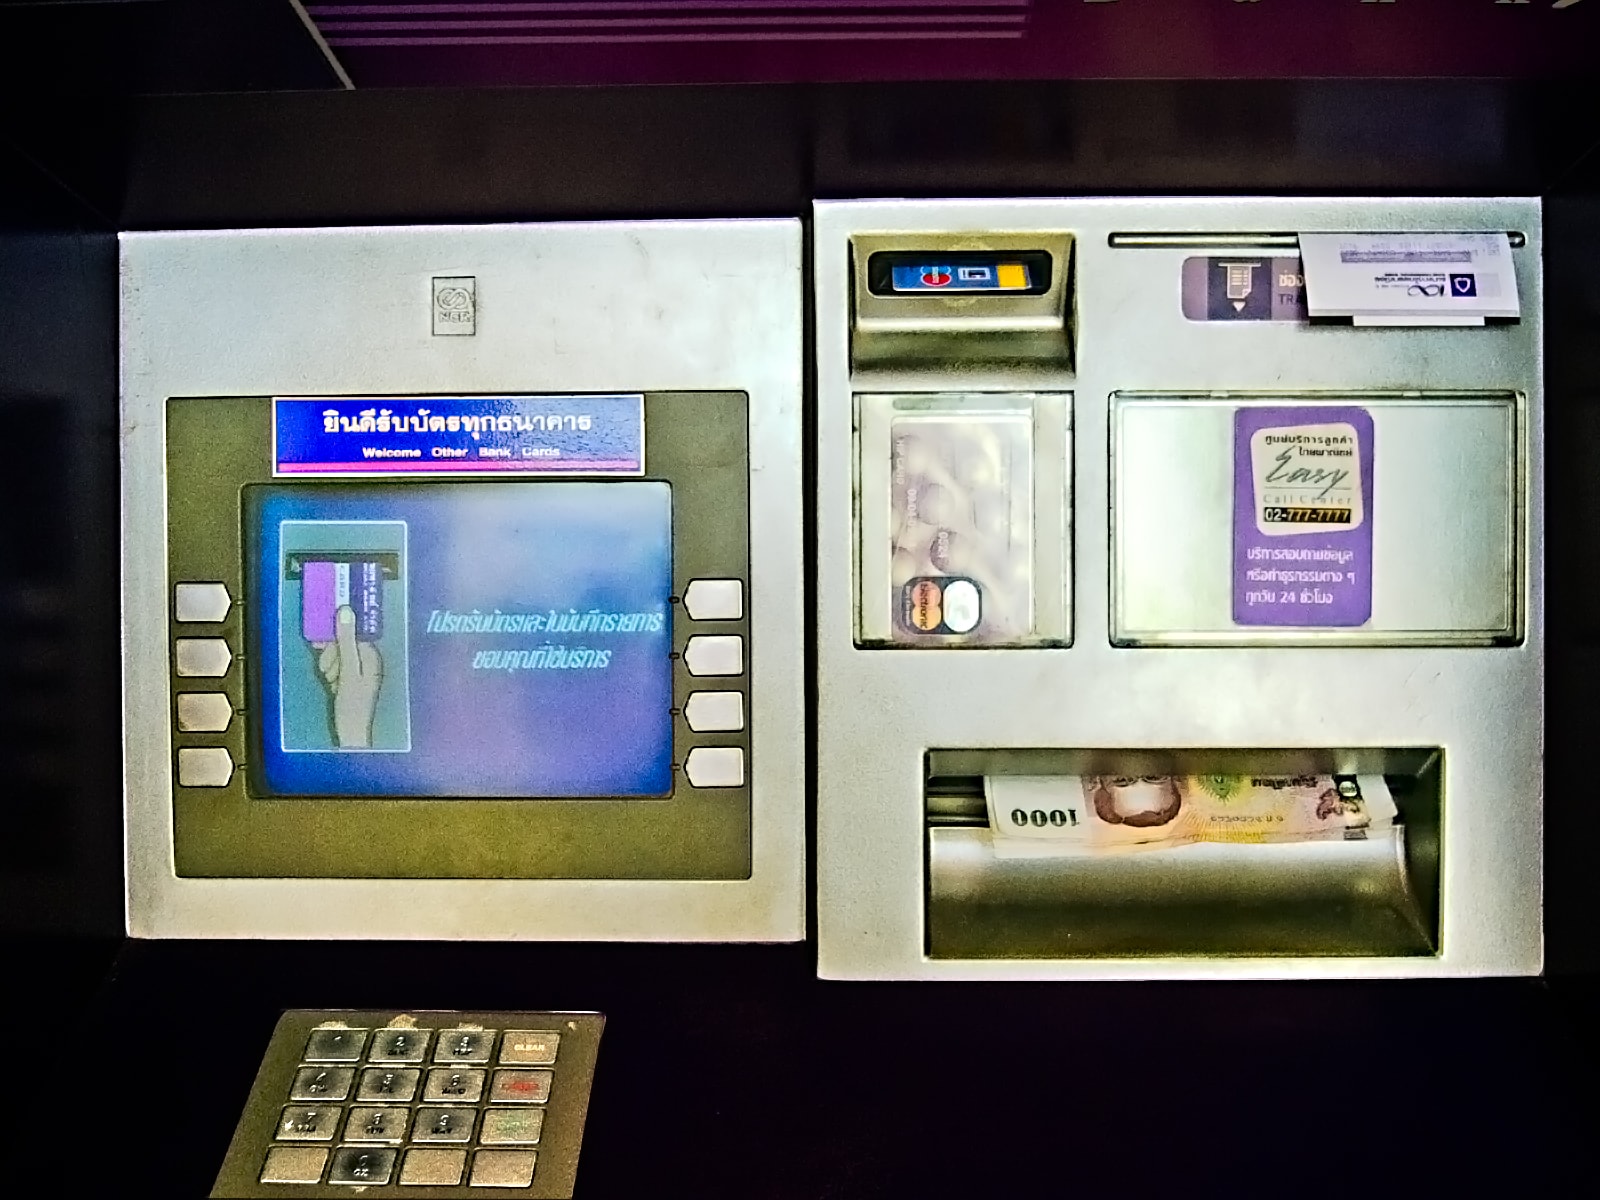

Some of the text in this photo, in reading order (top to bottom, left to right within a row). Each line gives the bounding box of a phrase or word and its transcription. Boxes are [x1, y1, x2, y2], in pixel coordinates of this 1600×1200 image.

[323, 408, 591, 440] ยินดีรับบัตรทุกธนาคาร
[362, 447, 560, 458] Welcome Other Bank Cards
[1265, 445, 1349, 500] Easy
[1263, 495, 1351, 505] Call Center
[1265, 507, 1349, 523] 02-777-7777
[1245, 590, 1276, 606] ทุกวัน
[1280, 592, 1295, 603] 24
[1010, 808, 1080, 827] 1000
[514, 1043, 545, 1051] CLEAR
